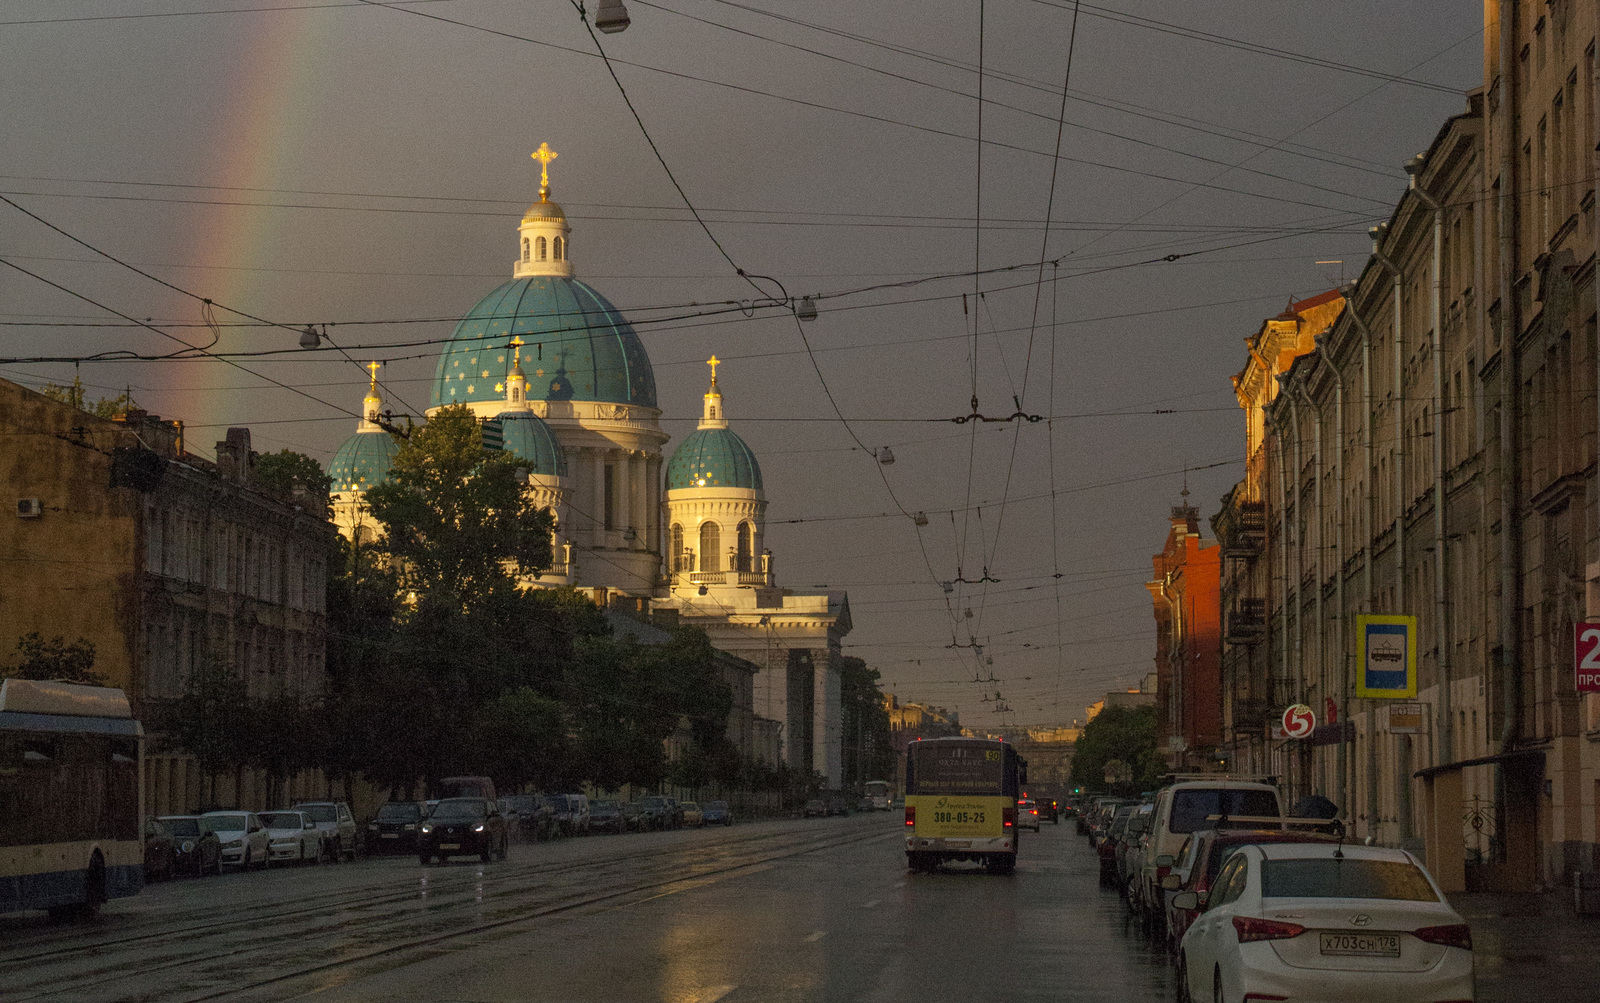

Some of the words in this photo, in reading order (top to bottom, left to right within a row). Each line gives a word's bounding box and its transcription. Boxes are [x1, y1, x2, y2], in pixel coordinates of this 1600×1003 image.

[1290, 707, 1310, 737] 5
[988, 751, 999, 761] 90
[934, 812, 985, 823] 380-05-25
[1377, 937, 1396, 947] 178
